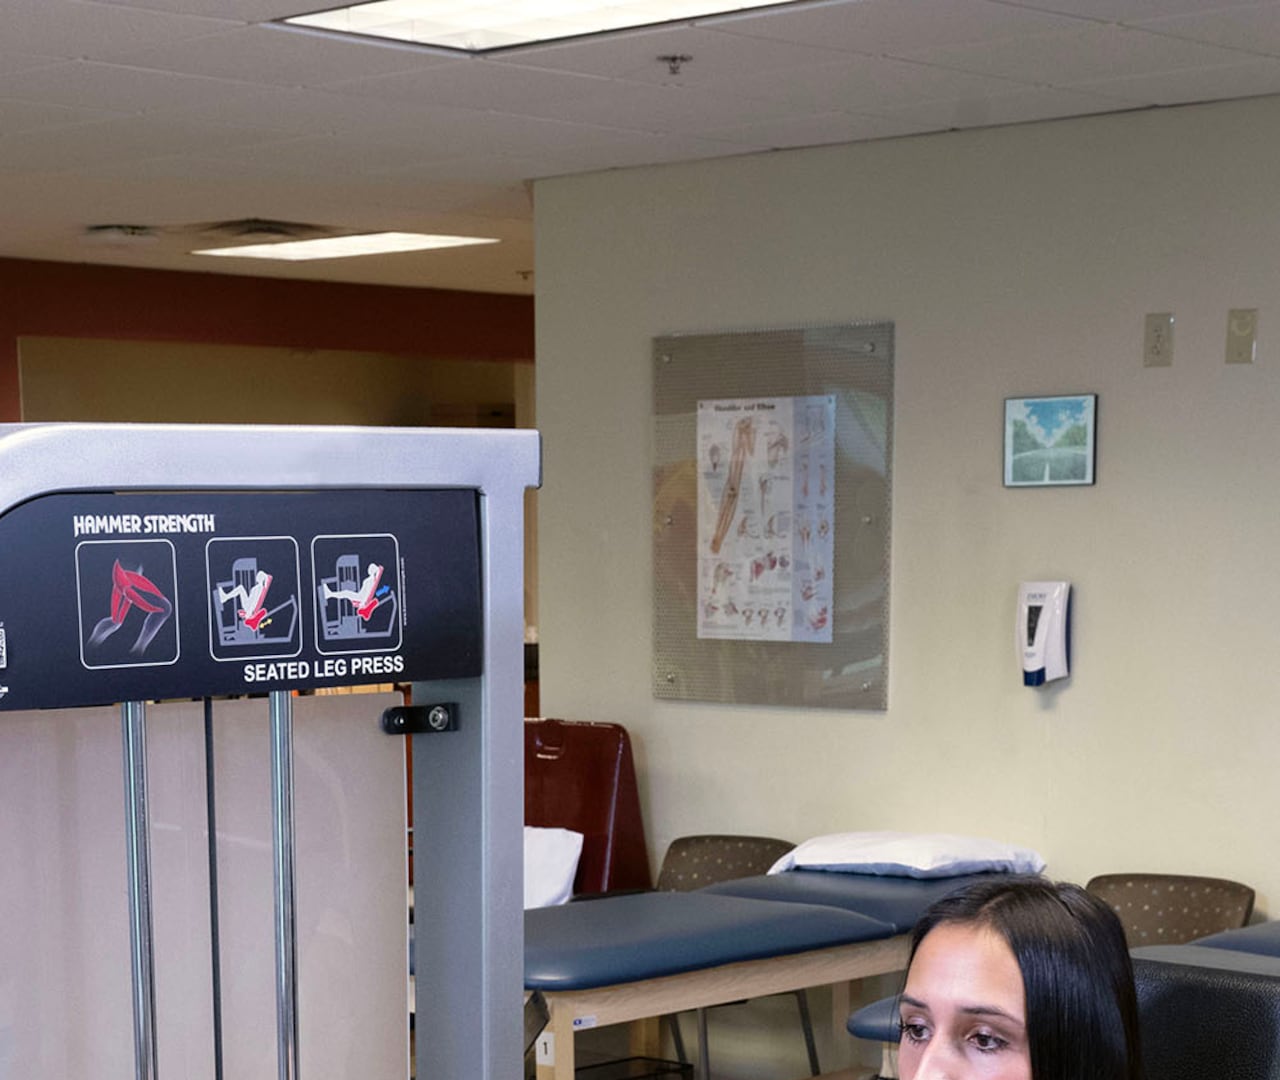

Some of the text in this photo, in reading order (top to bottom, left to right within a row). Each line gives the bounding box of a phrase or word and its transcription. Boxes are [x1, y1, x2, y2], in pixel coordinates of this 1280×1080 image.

[73, 513, 216, 538] HAMMER STRENGTH
[244, 655, 404, 683] SEATED LEG PRESS
